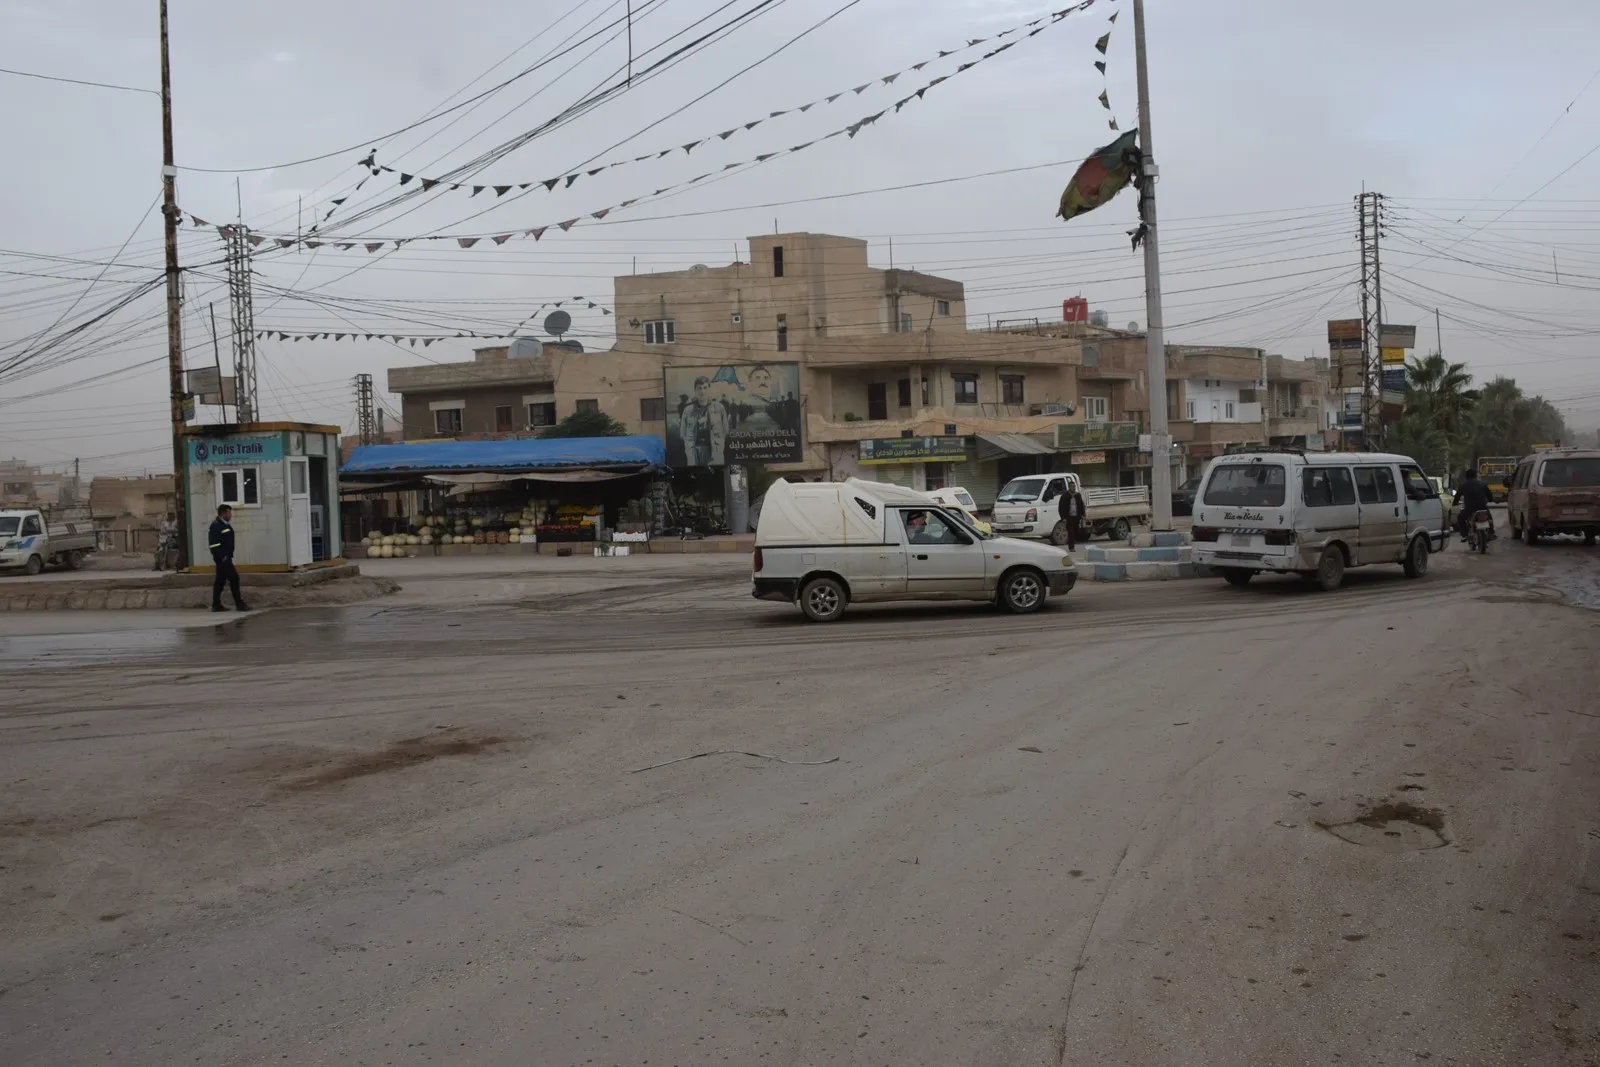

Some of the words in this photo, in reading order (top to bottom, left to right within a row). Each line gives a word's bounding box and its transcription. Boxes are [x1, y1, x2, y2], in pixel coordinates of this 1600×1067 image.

[729, 441, 744, 450] دليل
[745, 440, 771, 450] الشهيد
[772, 439, 795, 448] ساحة
[212, 444, 235, 455] Polis
[237, 442, 263, 454] Trafik
